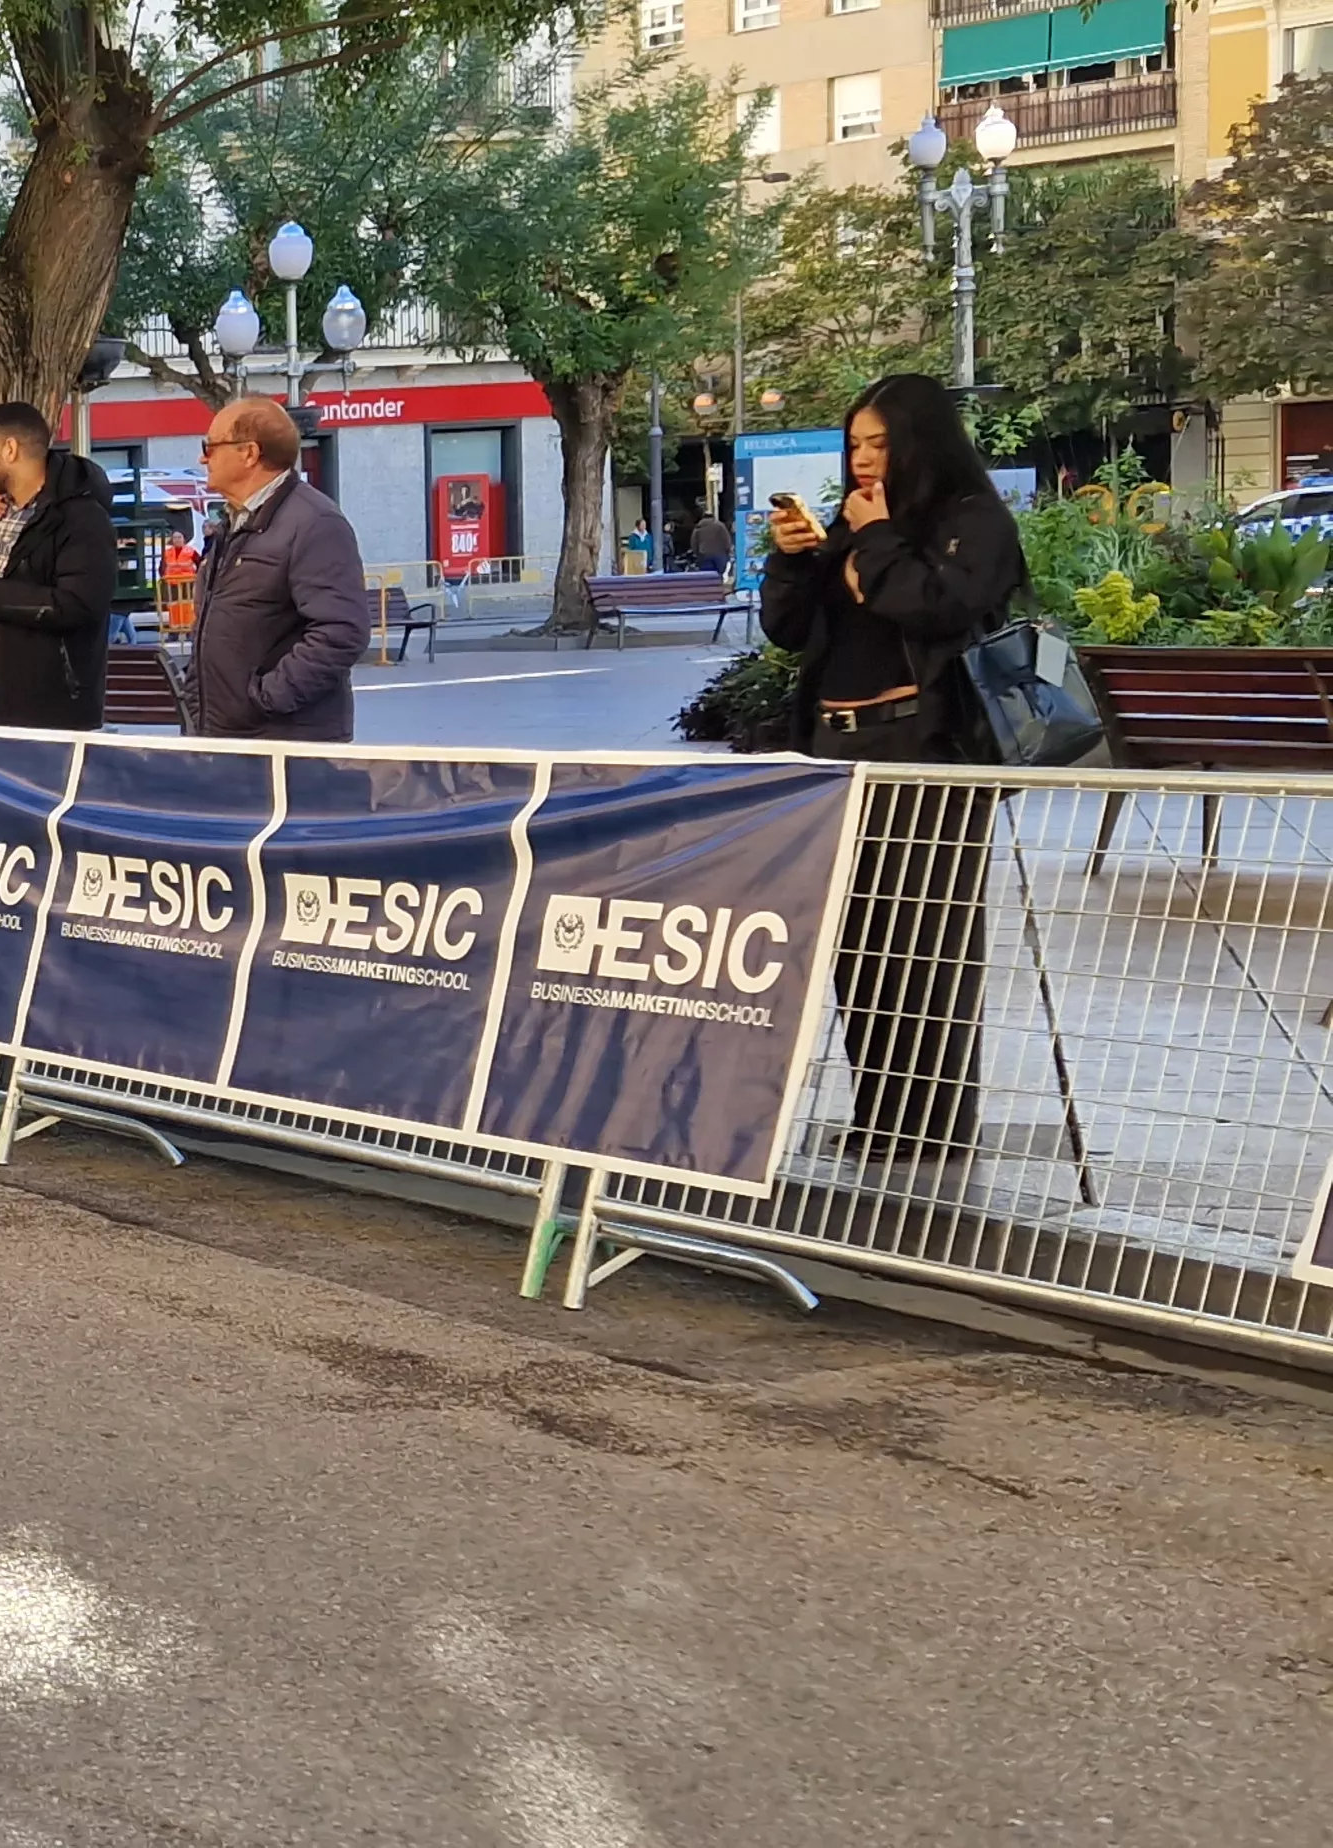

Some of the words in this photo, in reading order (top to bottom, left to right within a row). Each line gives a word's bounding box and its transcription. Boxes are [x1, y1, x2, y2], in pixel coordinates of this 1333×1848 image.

[107, 857, 234, 933] ESIC
[333, 877, 484, 961] ESIC
[60, 921, 224, 959] BUSINESS&MARKETINGSCHOOL
[271, 949, 472, 991] BUSINESS&MARKETINGSCHOOL
[596, 898, 789, 994] ESIC
[531, 981, 774, 1027] BUSINESS&MARKETINGSCHOOL
